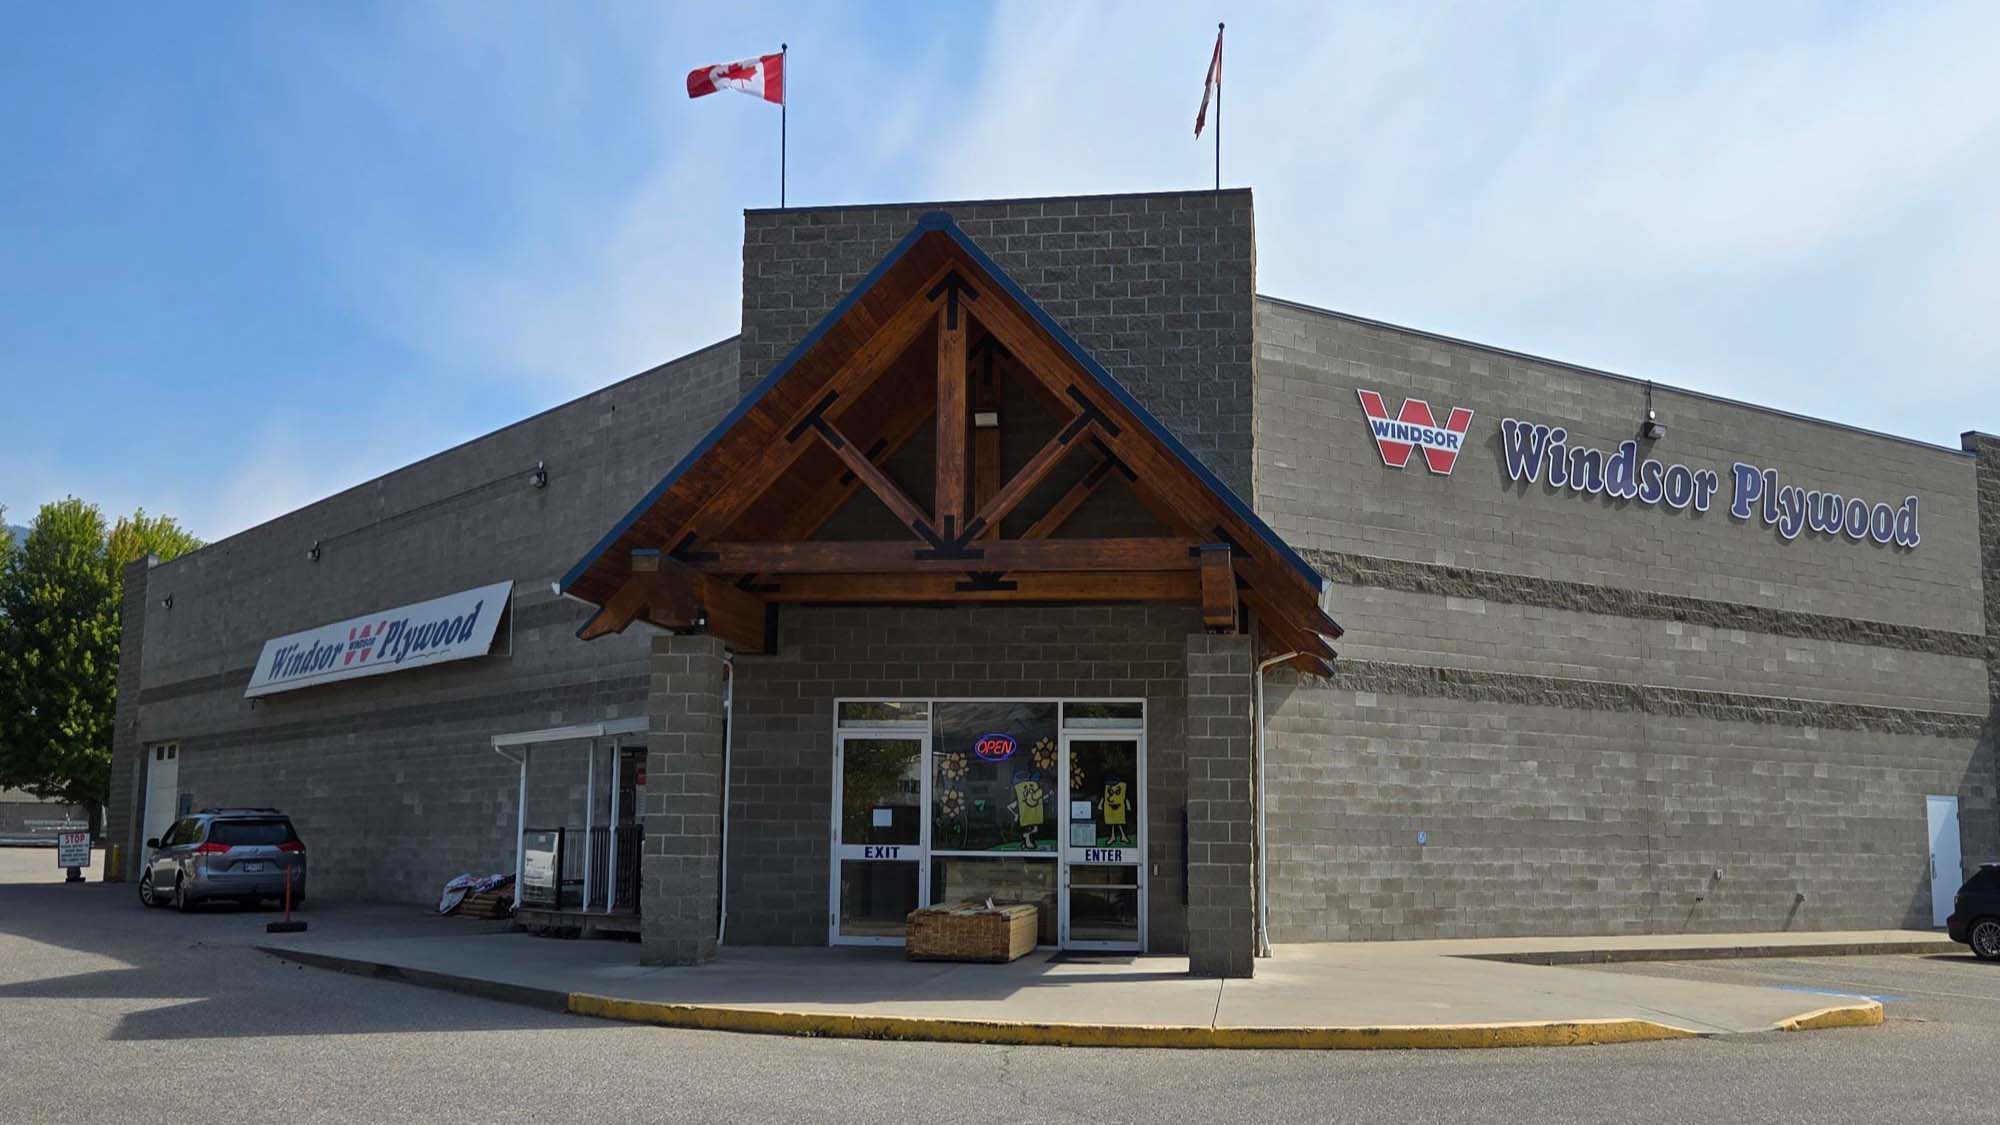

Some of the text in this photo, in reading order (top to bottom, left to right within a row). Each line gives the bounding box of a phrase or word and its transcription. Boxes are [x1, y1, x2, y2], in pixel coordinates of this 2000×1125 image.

[1372, 420, 1458, 449] WINDSOR
[1501, 418, 1920, 548] Windsor Plywood
[268, 600, 484, 681] Windsor Plywood
[977, 740, 1012, 755] OPEN
[64, 833, 85, 844] STOP
[865, 846, 900, 858] EXIT
[1085, 848, 1122, 862] ENTER
